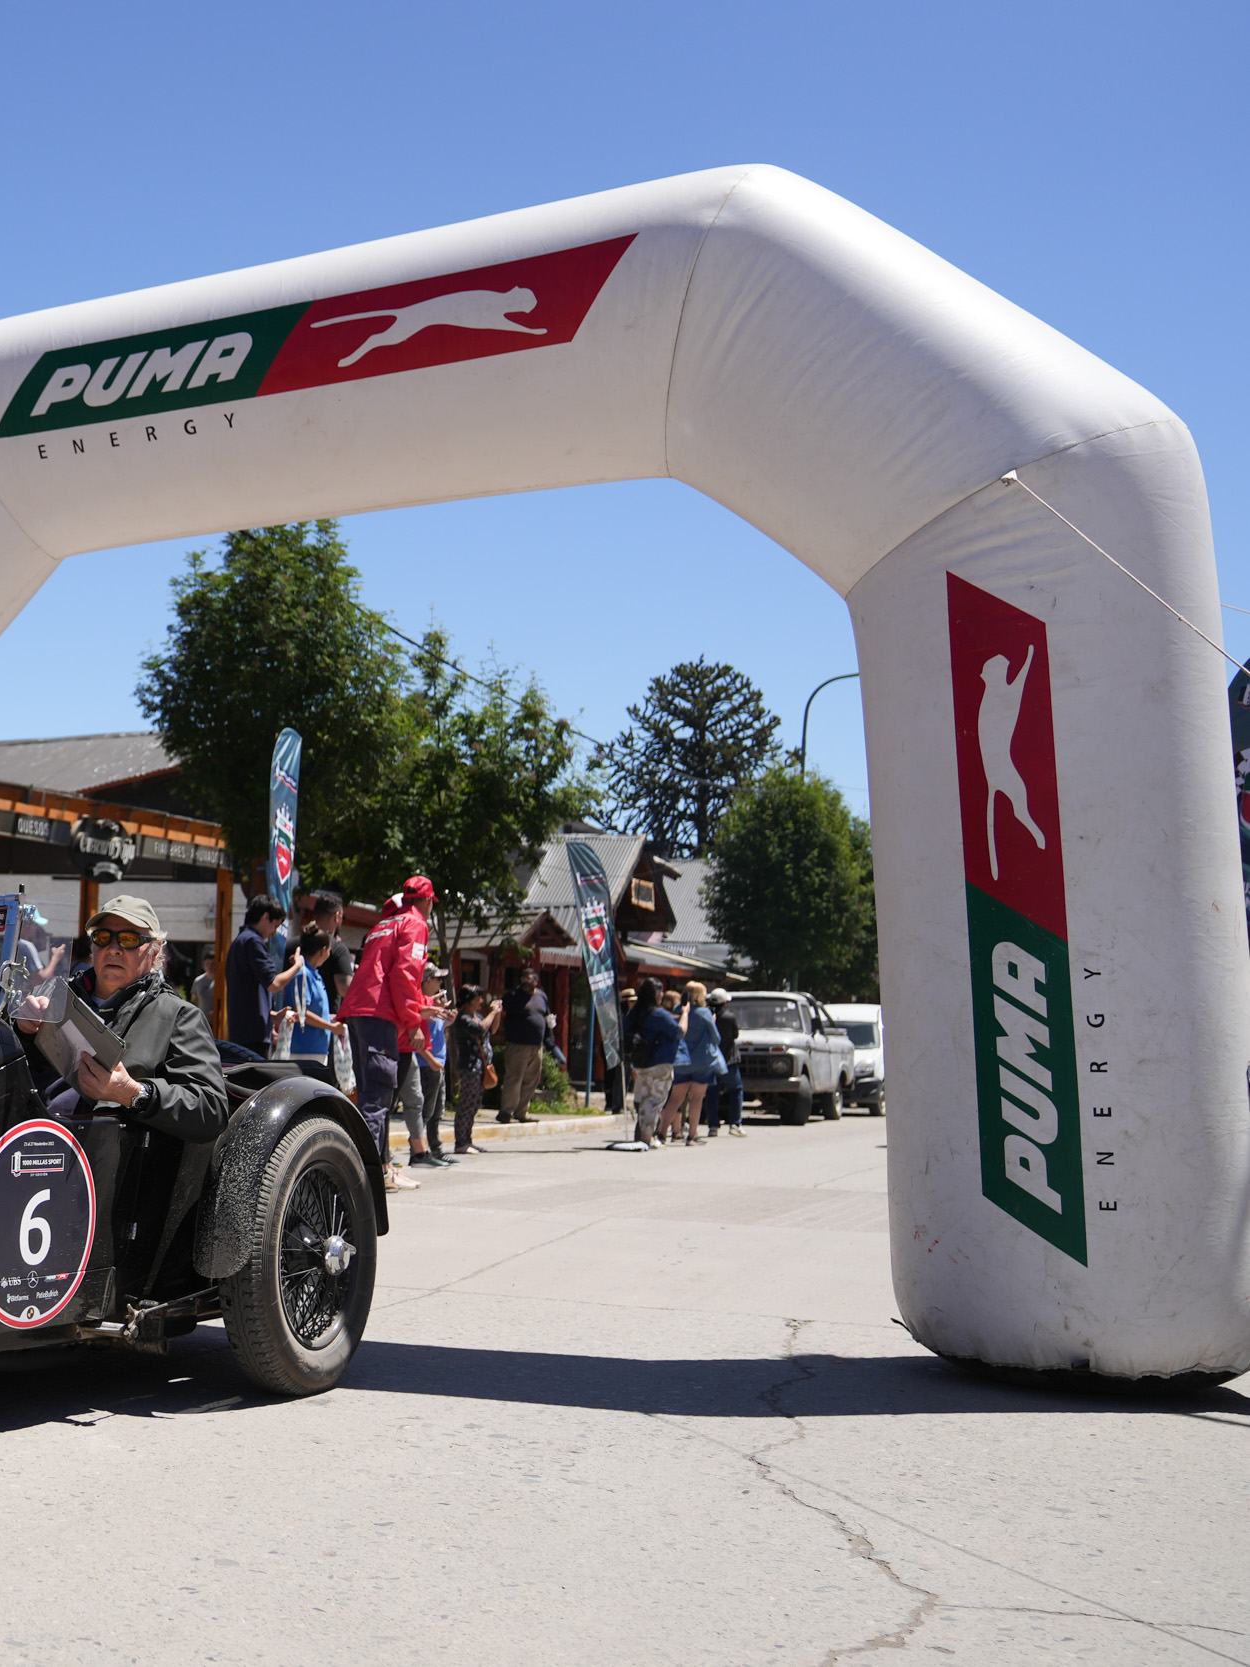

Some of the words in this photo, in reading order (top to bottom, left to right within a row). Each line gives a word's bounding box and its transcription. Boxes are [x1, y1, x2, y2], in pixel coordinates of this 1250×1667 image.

[30, 331, 253, 417] PUMA
[37, 413, 235, 460] ENERGY
[17, 817, 49, 836] QUESOS
[992, 941, 1062, 1215] PUMA
[1083, 967, 1118, 1211] ENERGY
[19, 1188, 52, 1266] 6
[8, 1276, 22, 1286] UBS
